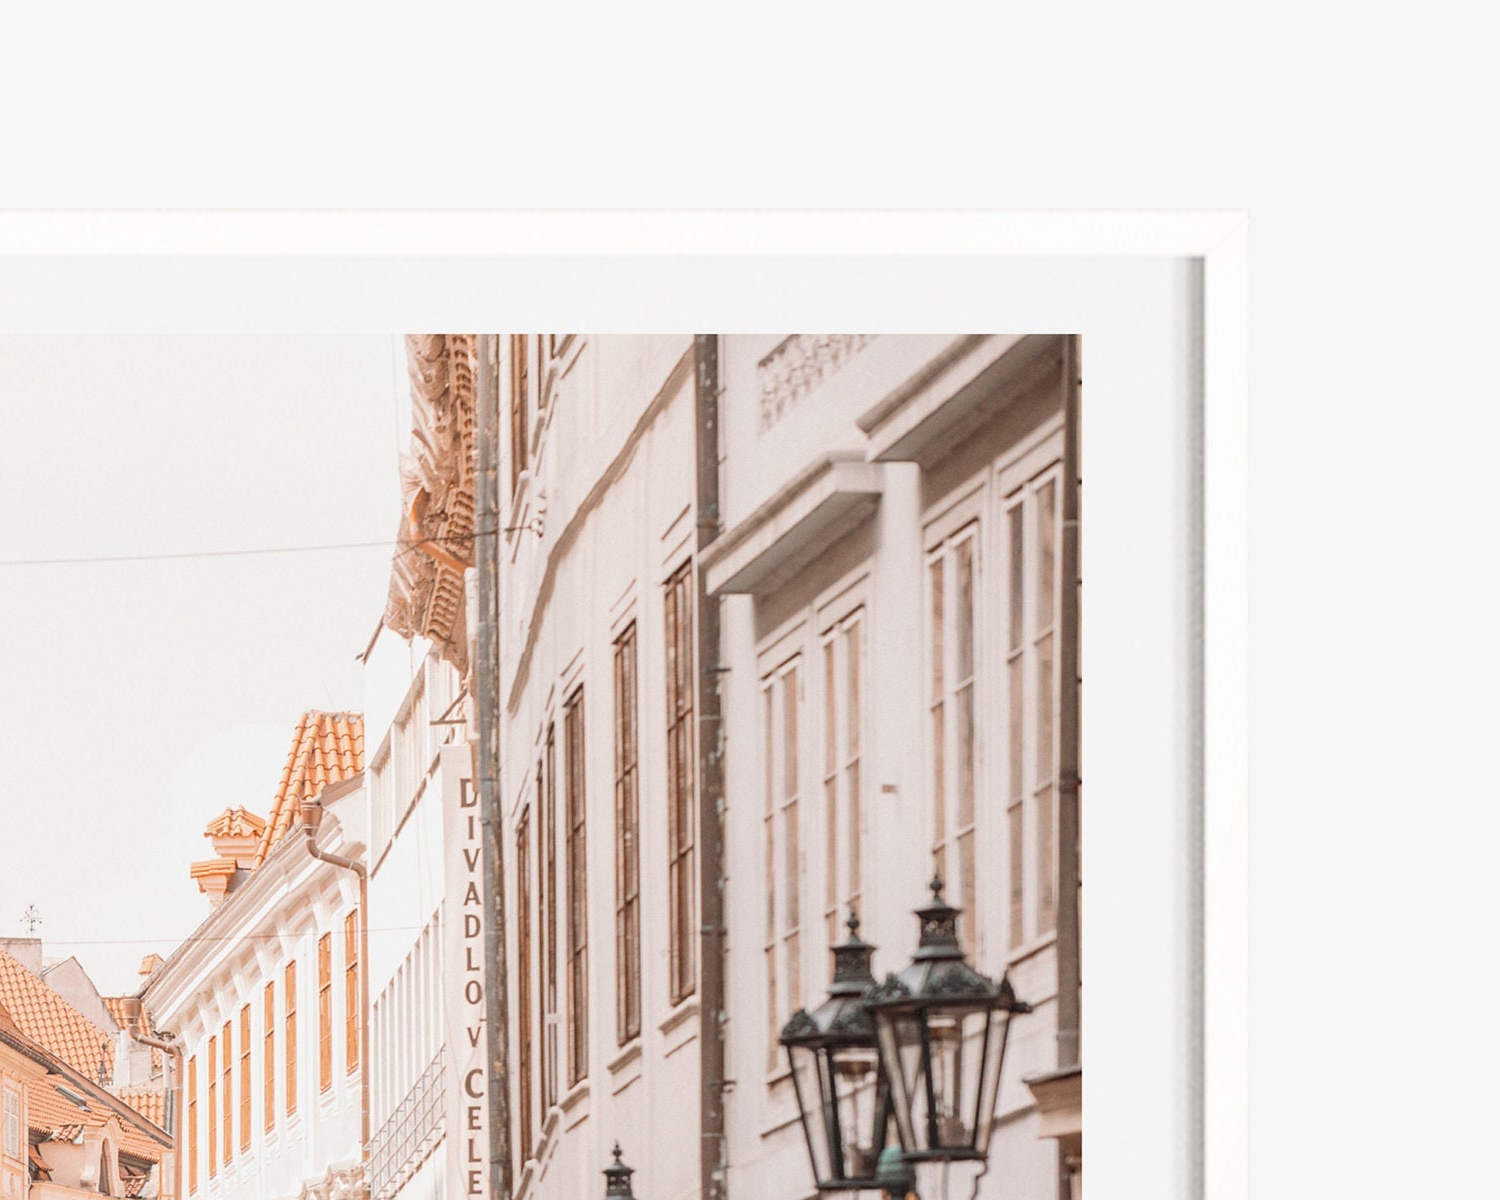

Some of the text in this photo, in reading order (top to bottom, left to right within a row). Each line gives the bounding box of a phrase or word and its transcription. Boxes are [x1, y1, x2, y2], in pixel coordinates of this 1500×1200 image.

[459, 778, 485, 1195] DIVADLO V CELE
